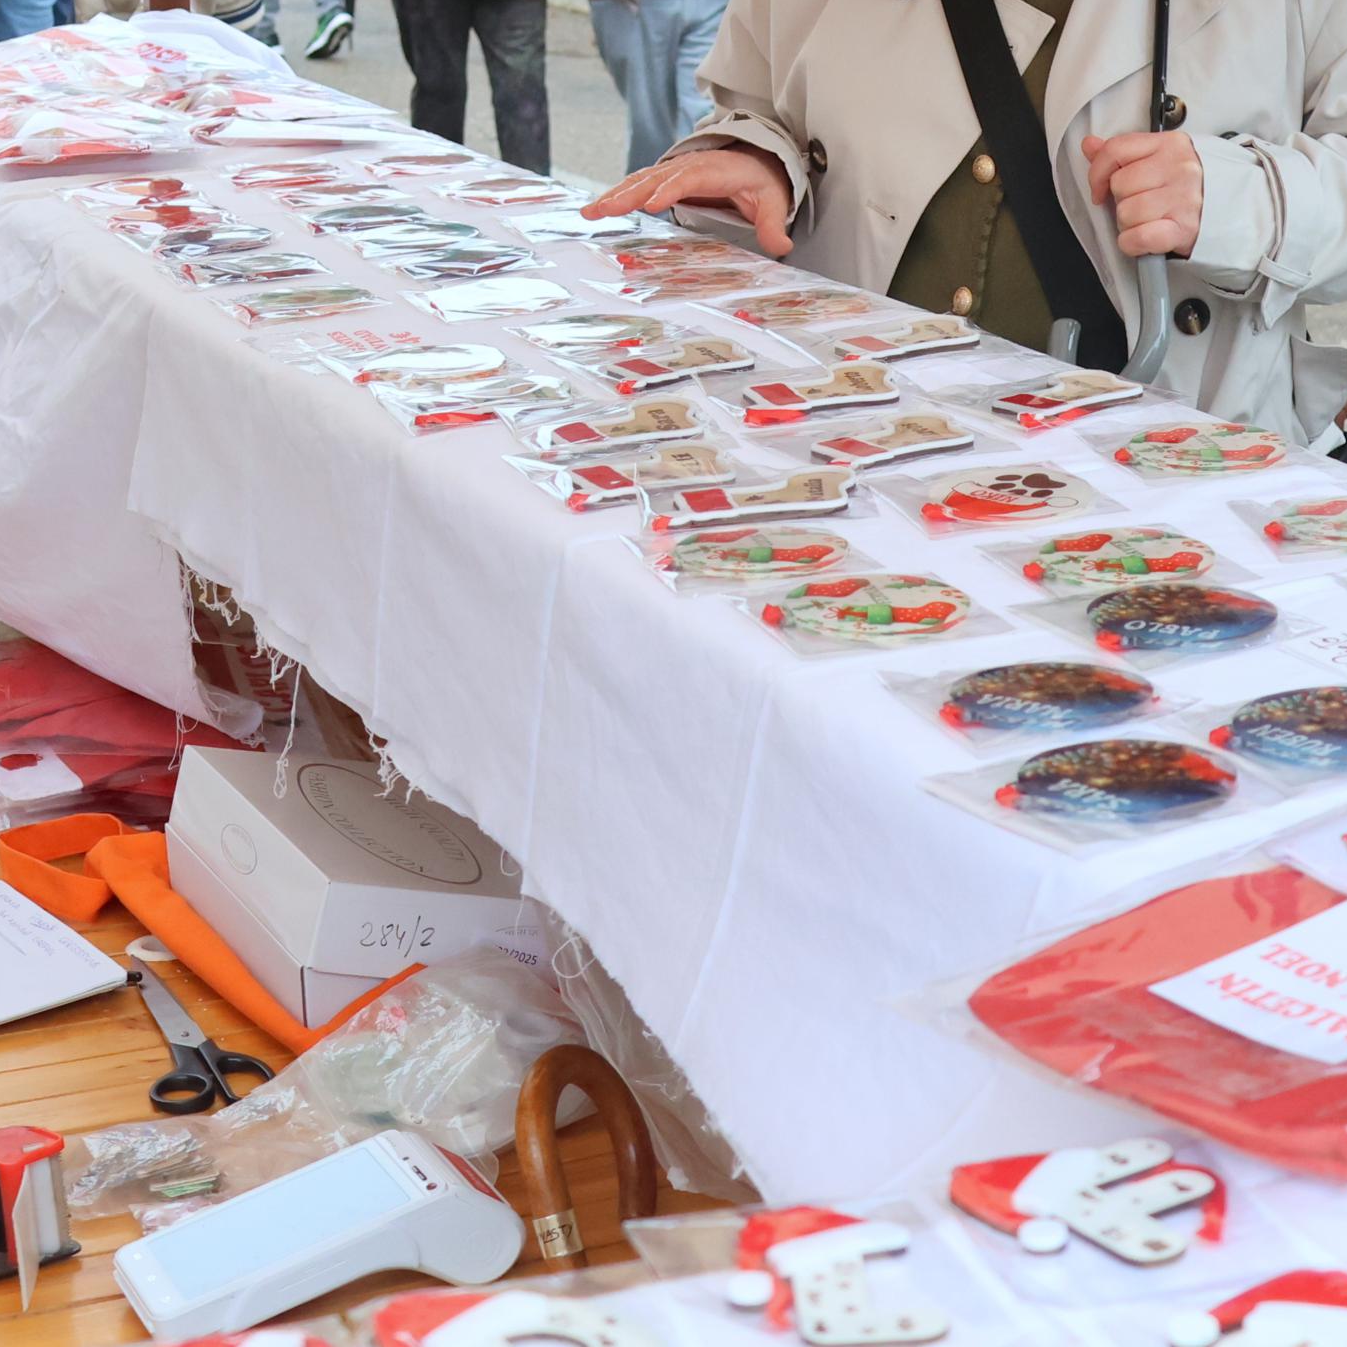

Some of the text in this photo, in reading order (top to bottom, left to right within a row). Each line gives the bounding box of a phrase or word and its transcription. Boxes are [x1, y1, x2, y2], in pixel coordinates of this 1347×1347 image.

[970, 489, 1022, 503] NIKO
[1123, 619, 1222, 641] PABLO
[1048, 778, 1133, 807] SARA
[359, 916, 436, 958] 284/2
